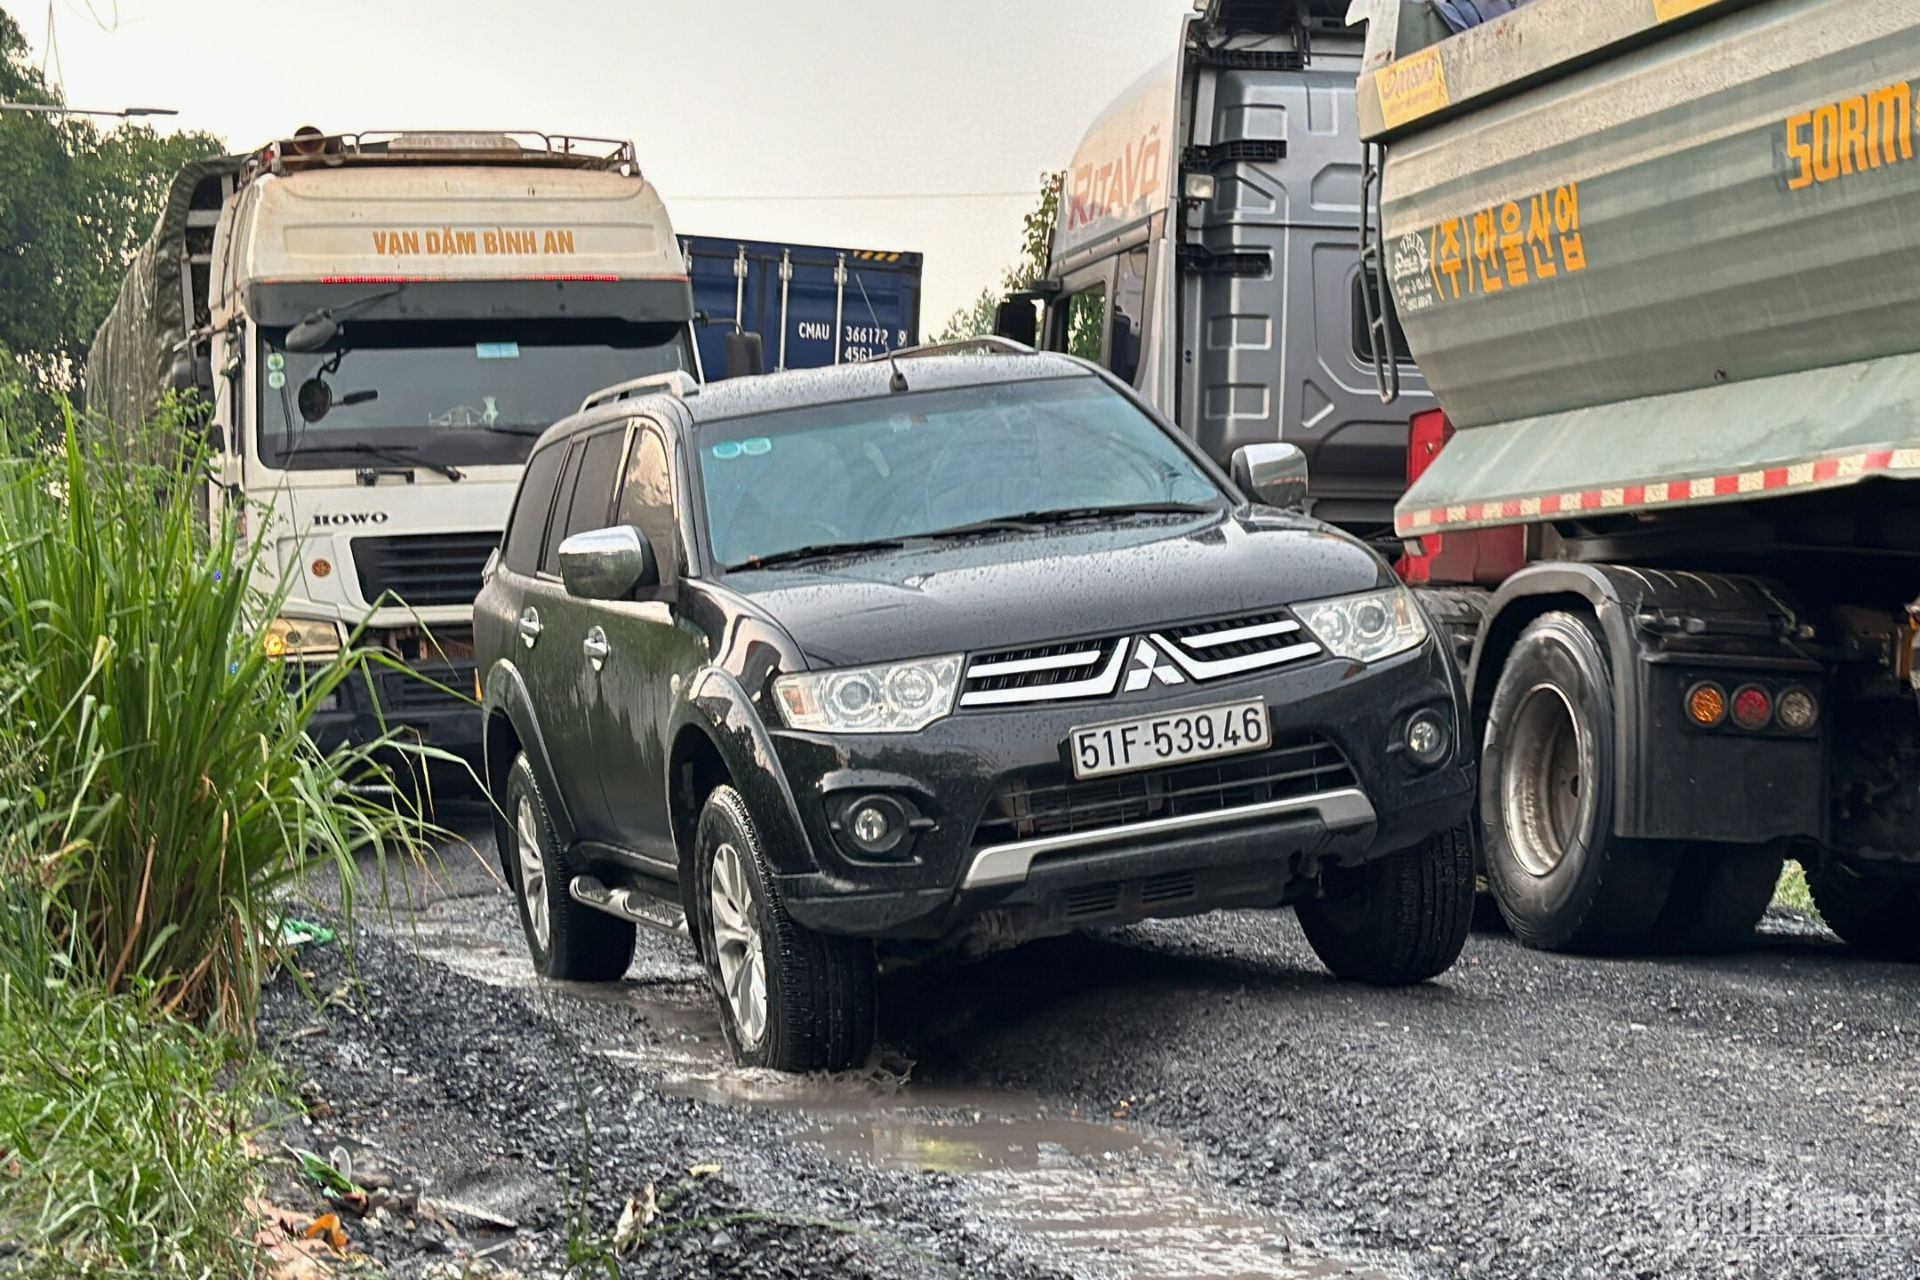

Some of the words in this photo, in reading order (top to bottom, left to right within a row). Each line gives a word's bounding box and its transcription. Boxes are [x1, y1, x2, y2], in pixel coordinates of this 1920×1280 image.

[483, 226, 538, 255] BÌNH
[543, 230, 575, 255] AN
[798, 322, 830, 341] CMAU
[313, 511, 389, 526] HOWO
[1078, 706, 1262, 769] 51F-539.46
